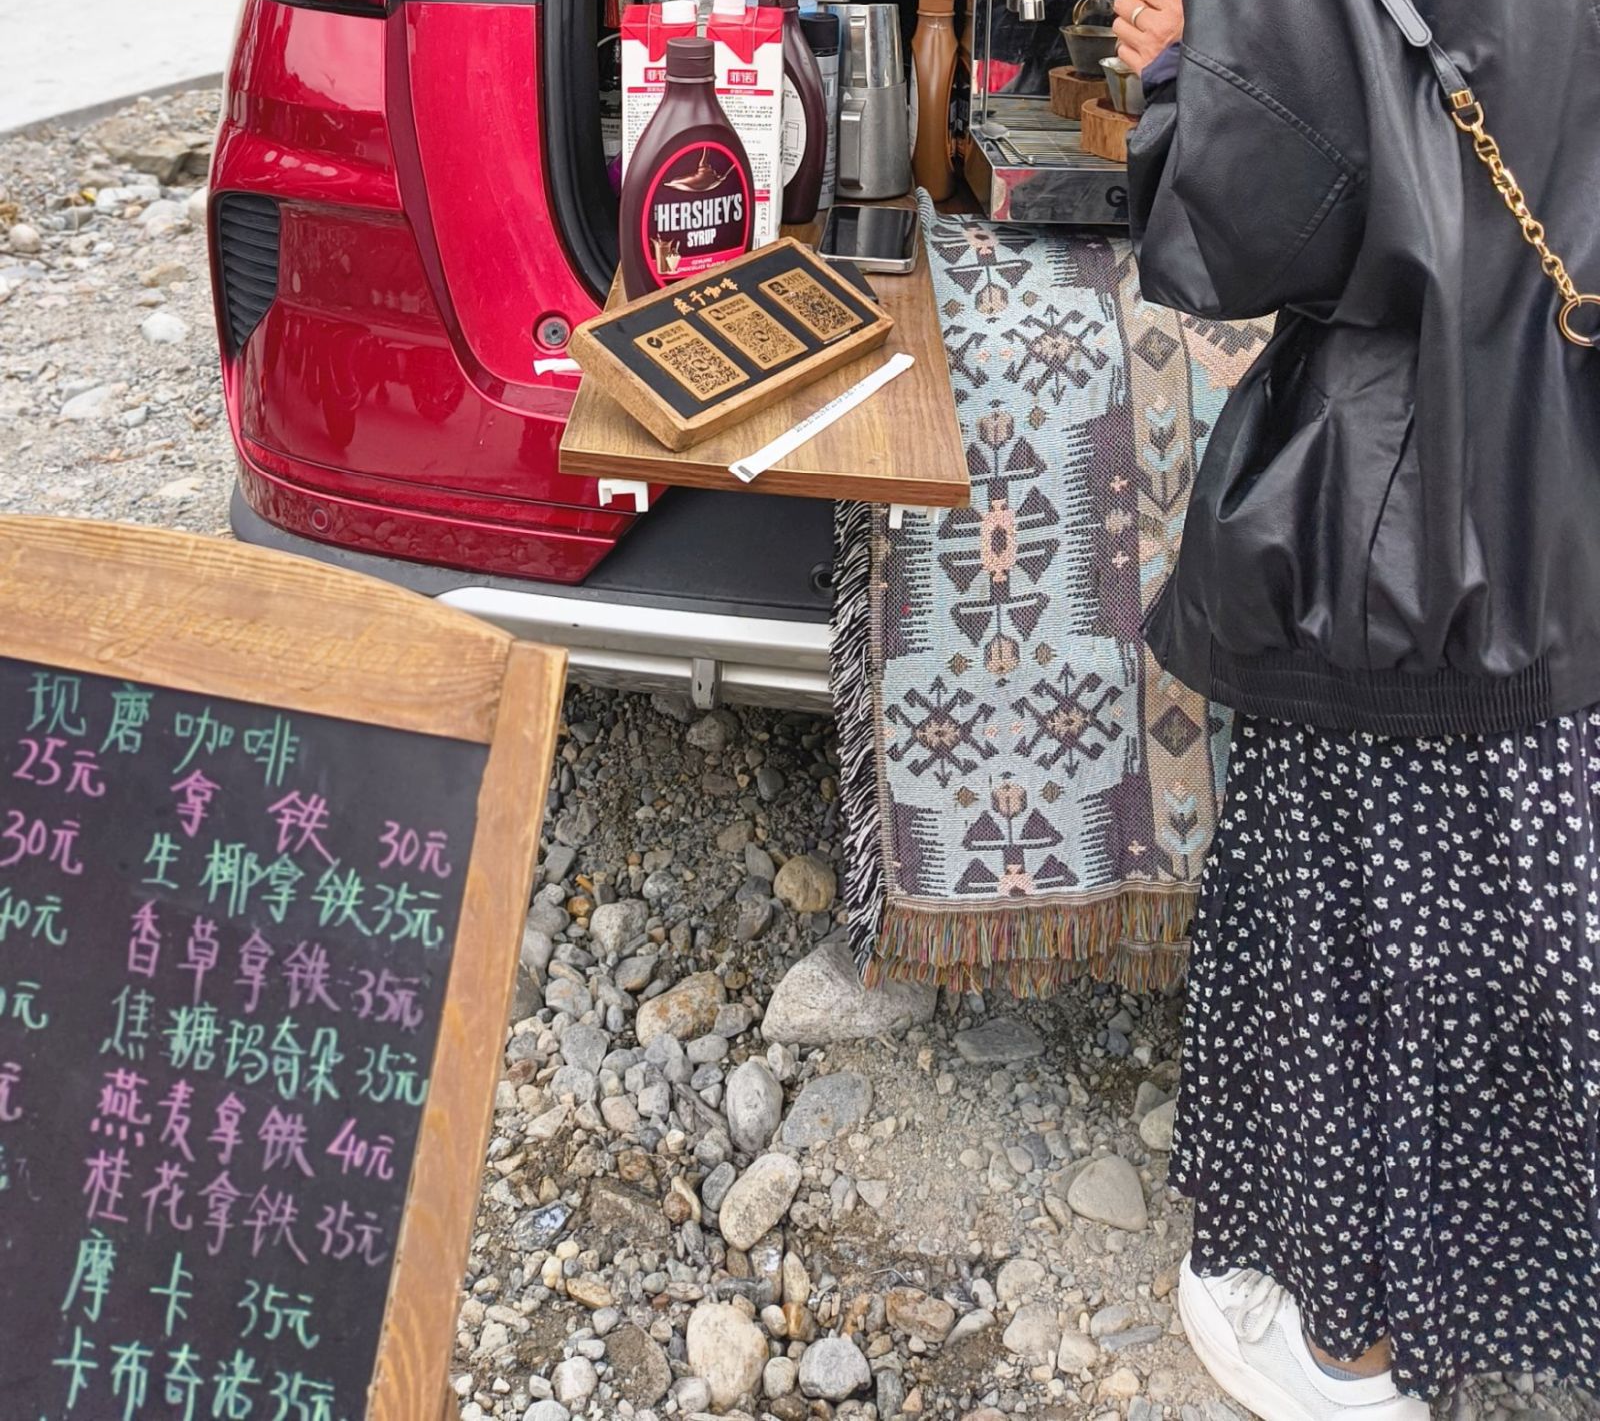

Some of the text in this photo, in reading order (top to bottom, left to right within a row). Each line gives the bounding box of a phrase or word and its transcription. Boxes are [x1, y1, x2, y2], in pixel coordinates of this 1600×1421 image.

[657, 193, 743, 232] HERSHEY'S
[687, 228, 717, 248] SYRUP
[12, 737, 106, 798] 25元
[26, 672, 300, 786] 现磨咖啡
[0, 810, 83, 875] 30元
[170, 768, 451, 878] 拿铁 30元
[141, 832, 445, 947] 生椰拿铁 35元
[128, 898, 341, 1012] 香草拿铁
[353, 968, 424, 1028] 35元
[99, 984, 346, 1105] 焦糖玛奇朵
[355, 1043, 430, 1106] 35元
[90, 1067, 314, 1177] 燕麦拿铁
[325, 1117, 395, 1180] 40元
[83, 1147, 309, 1265] 桂花拿铁
[316, 1199, 388, 1266] 35元
[61, 1228, 319, 1350] 摩卡 35元
[52, 1325, 262, 1421] 卡布奇诺
